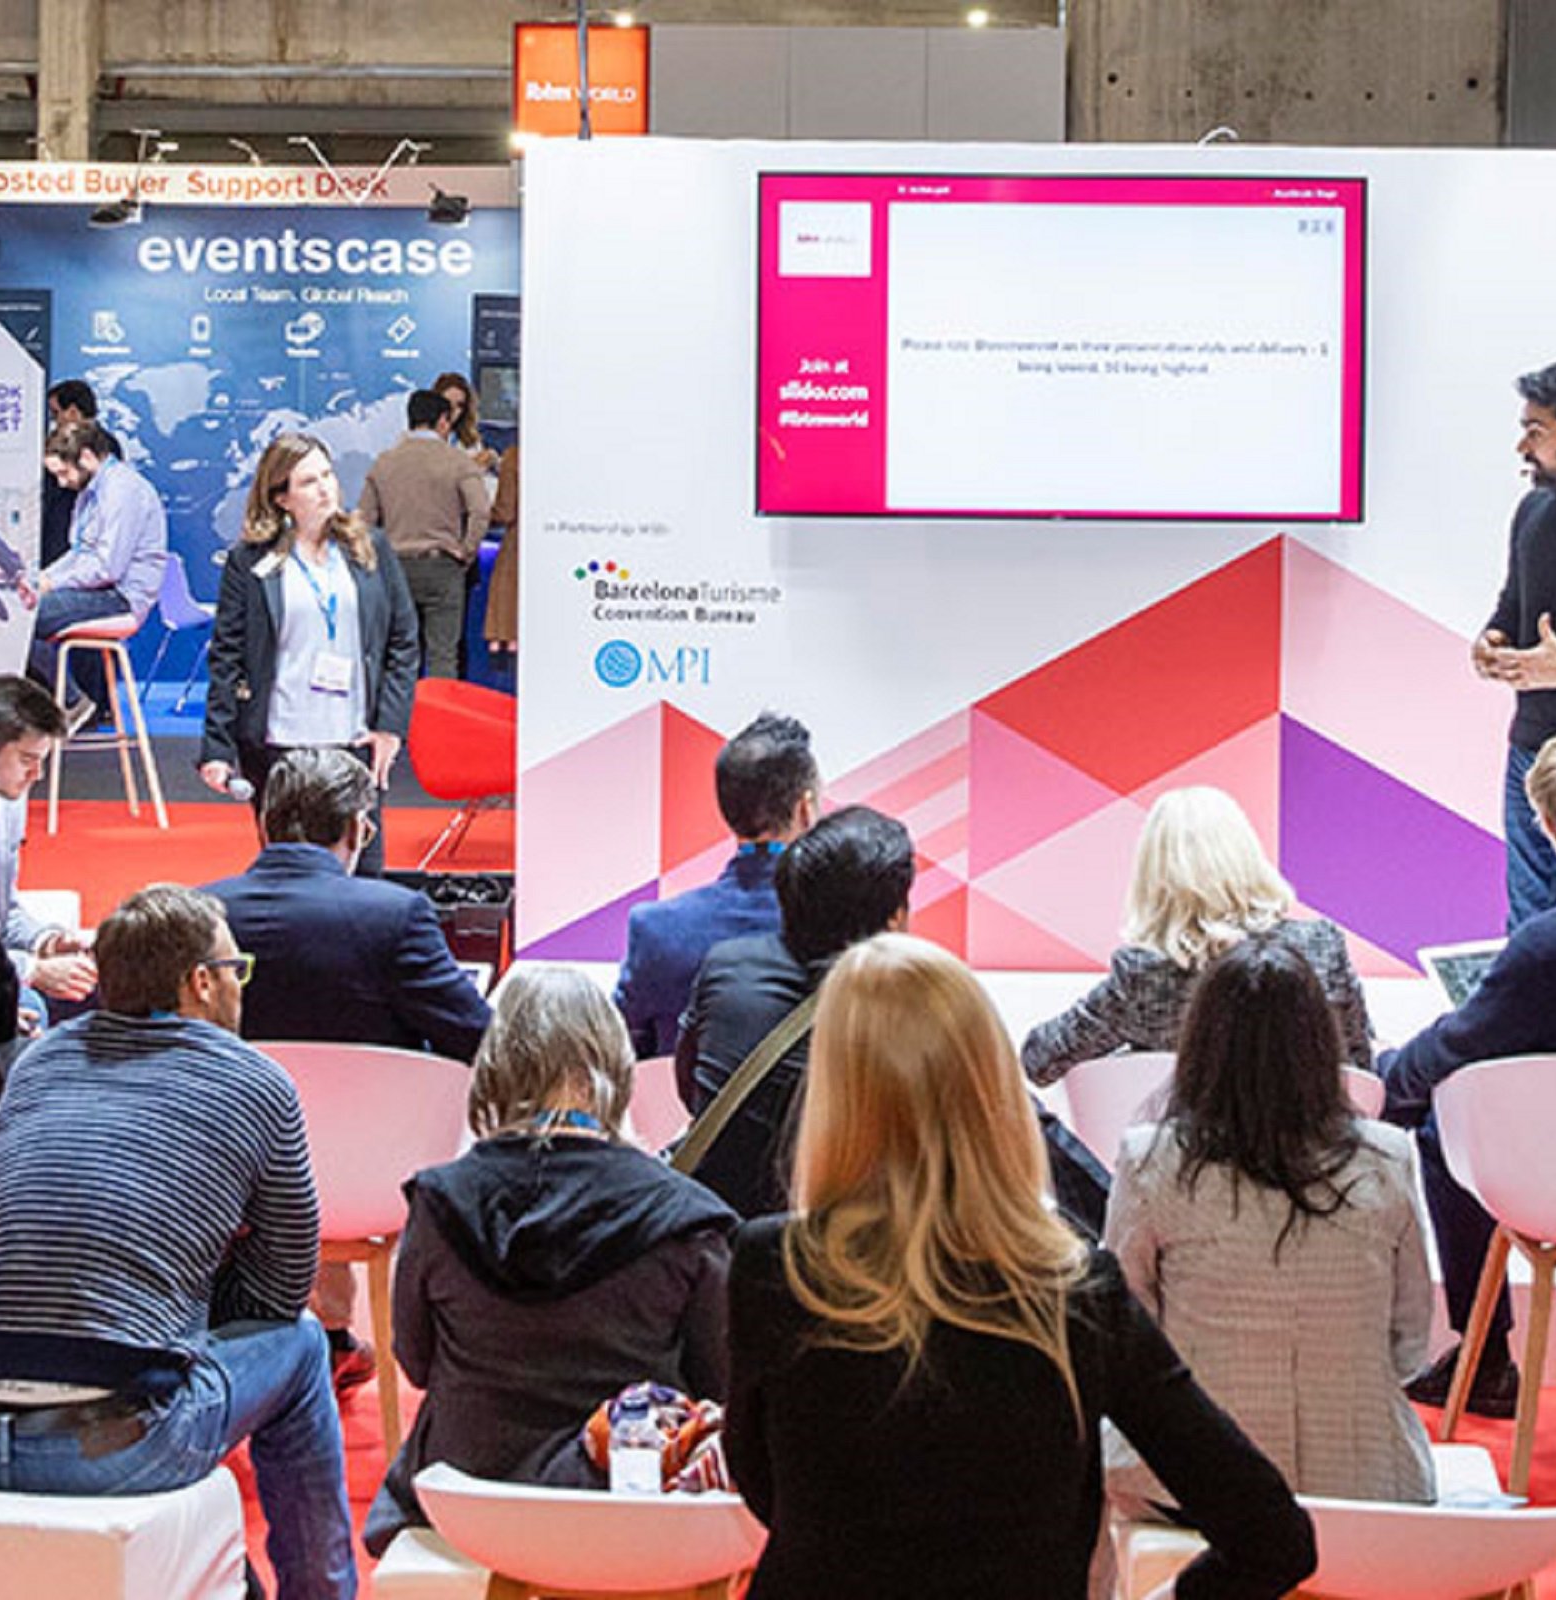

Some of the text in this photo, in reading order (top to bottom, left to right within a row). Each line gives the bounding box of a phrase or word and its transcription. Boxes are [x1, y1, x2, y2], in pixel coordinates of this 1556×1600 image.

[84, 170, 169, 201] Buyer
[187, 171, 306, 201] Support
[138, 230, 474, 275] eventscase
[205, 287, 246, 302] Local
[302, 287, 352, 302] Global
[357, 287, 408, 302] Reach
[799, 357, 830, 374] Join
[779, 380, 869, 401] slido.com
[594, 580, 782, 603] BarcelonaTurisme
[593, 604, 756, 624] Convention Bureau
[648, 647, 711, 684] MPI
